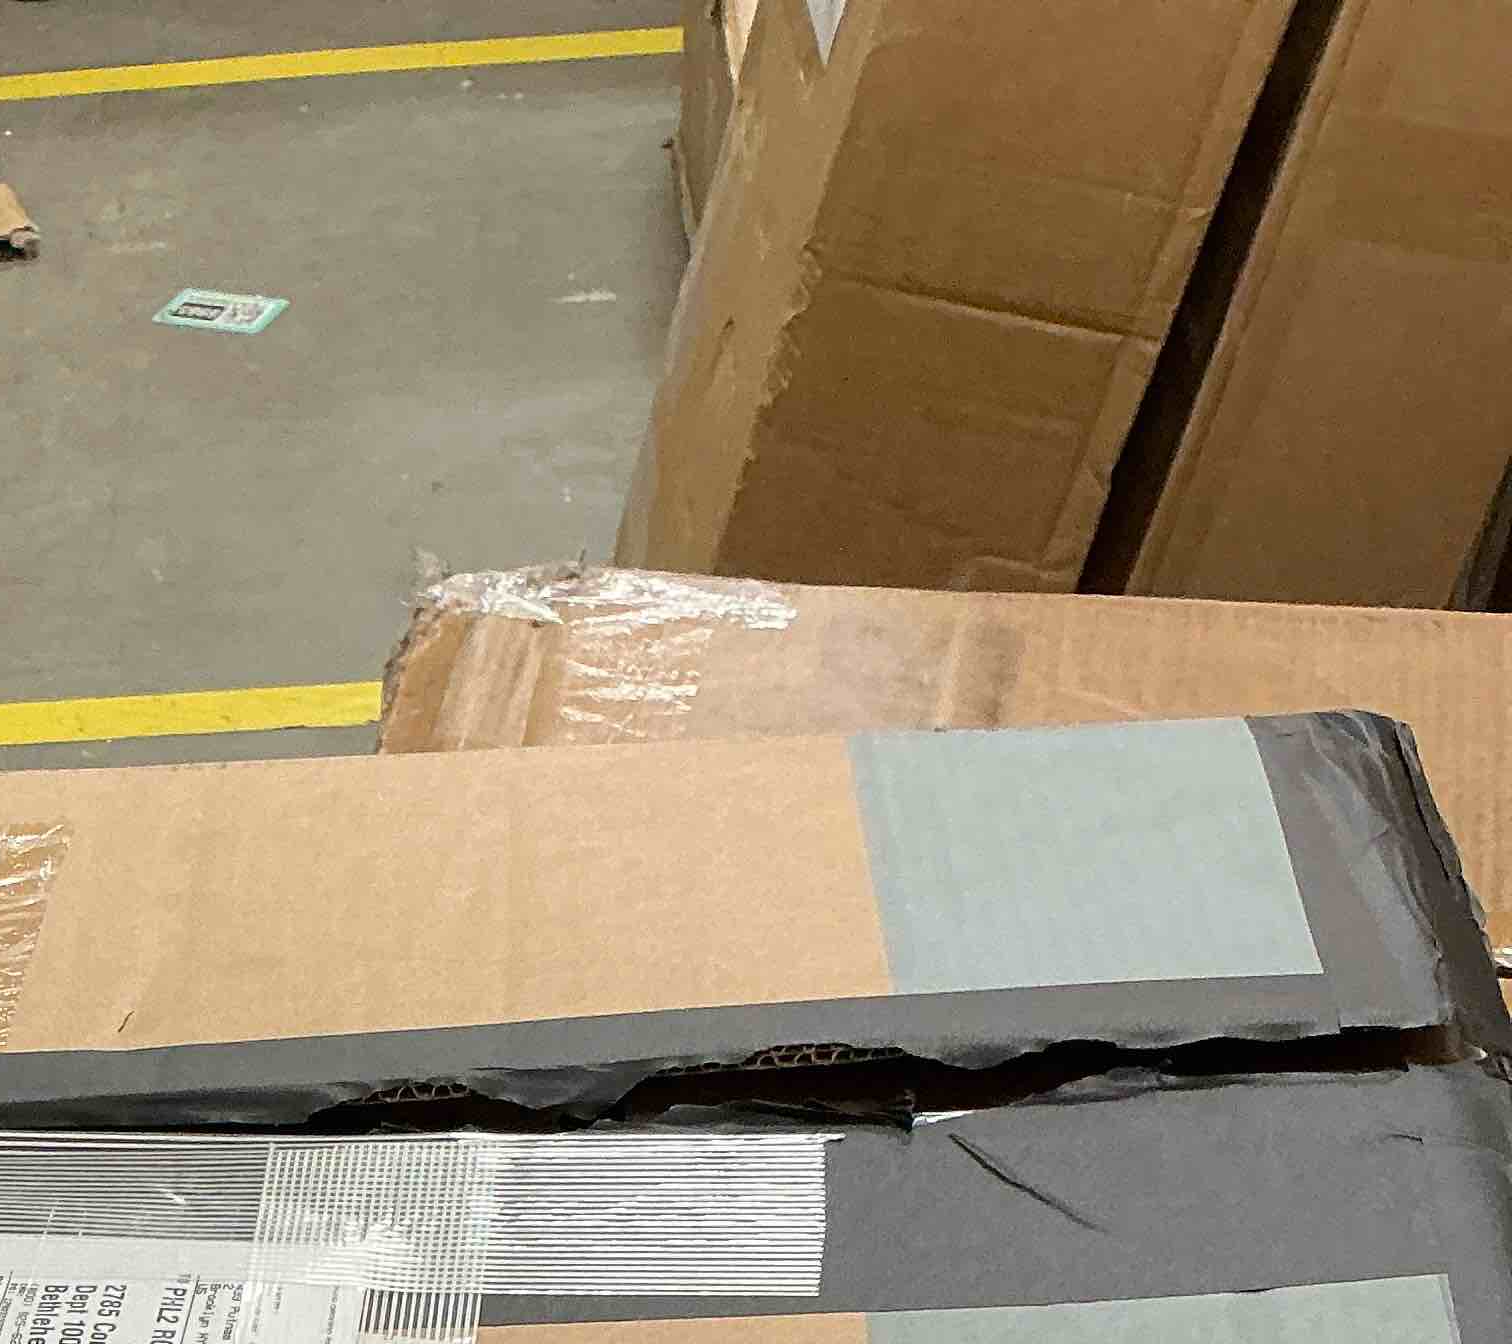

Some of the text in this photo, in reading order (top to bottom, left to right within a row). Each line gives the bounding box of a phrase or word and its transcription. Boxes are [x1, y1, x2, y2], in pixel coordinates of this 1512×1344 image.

[65, 1284, 97, 1315] Dept
[96, 1284, 128, 1318] 2785
[155, 1286, 188, 1325] PHL2
[197, 1283, 222, 1329] Brooklyn
